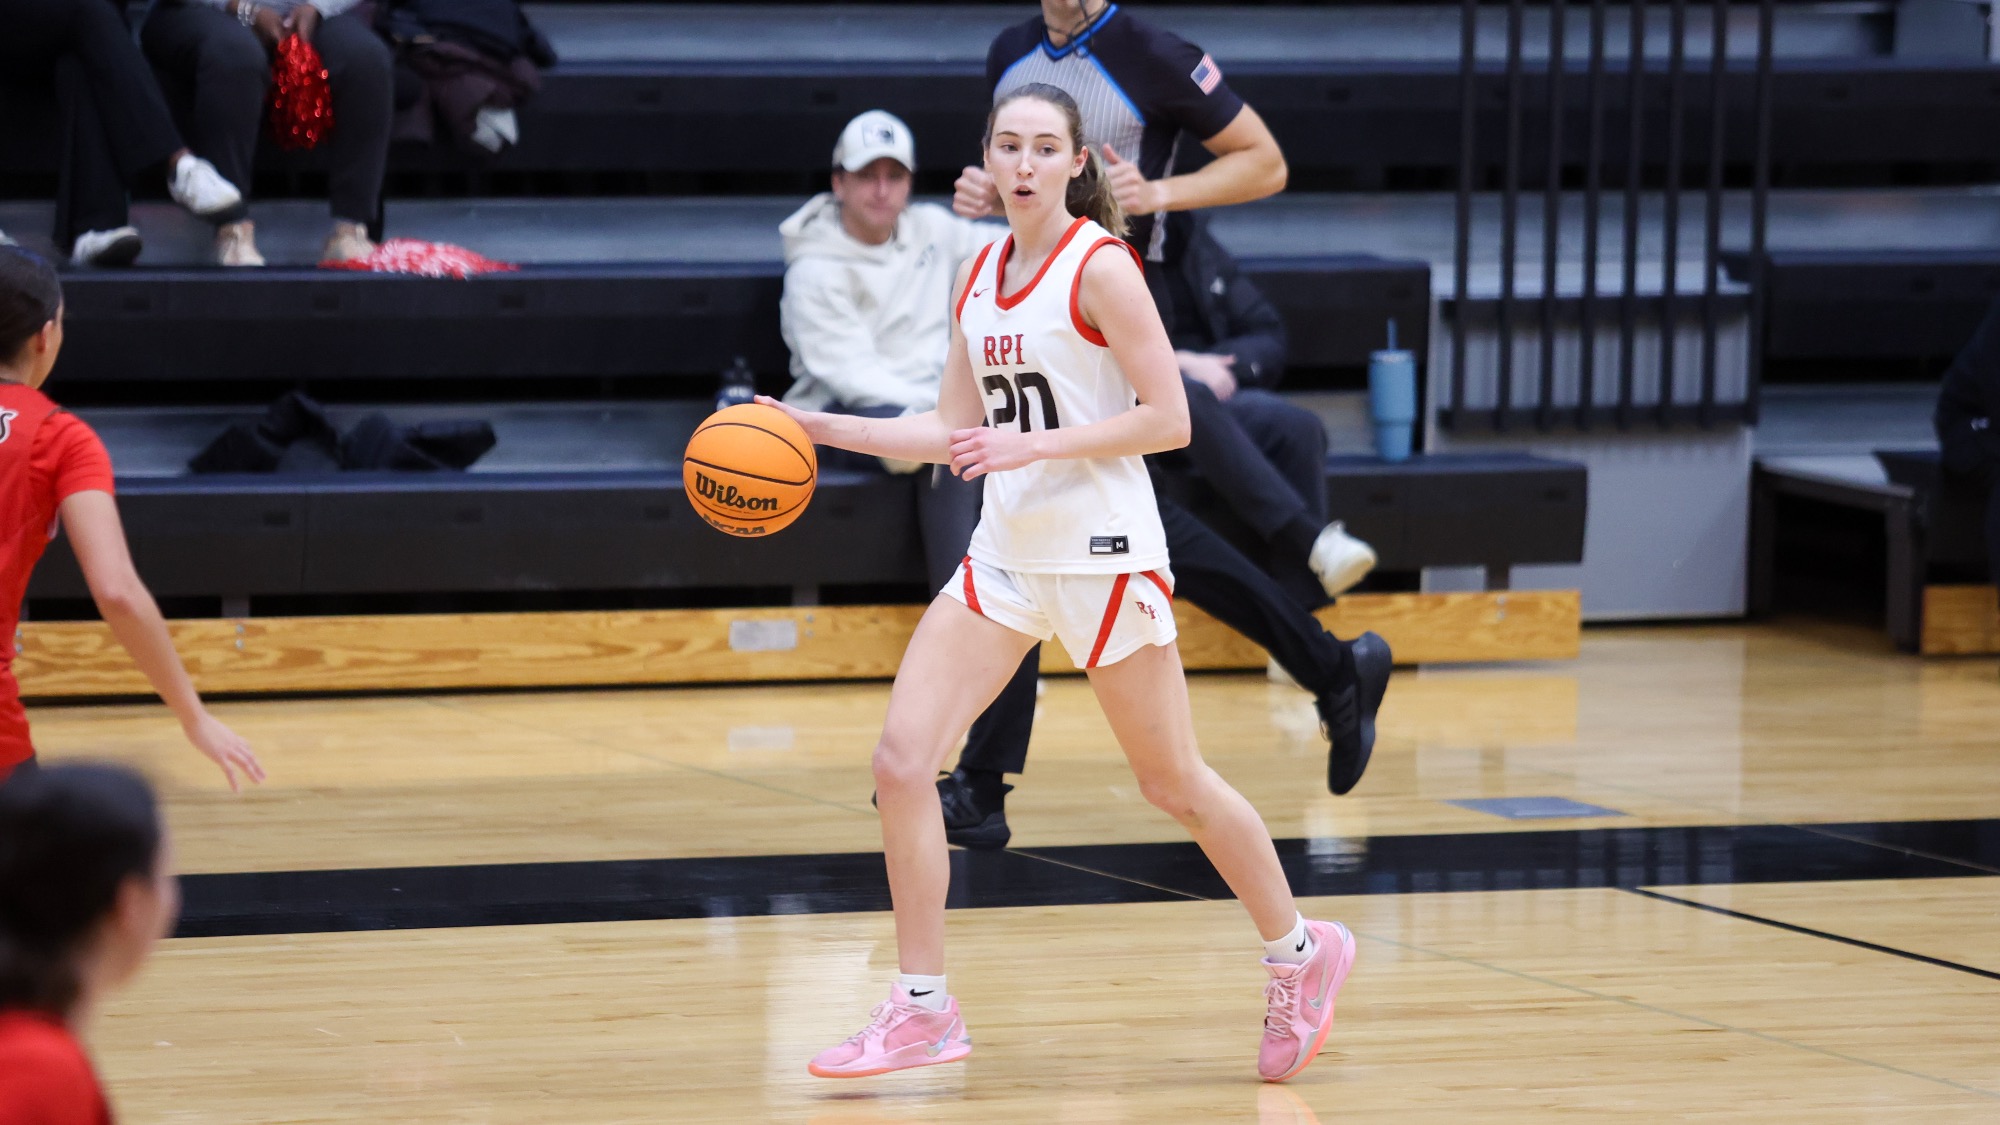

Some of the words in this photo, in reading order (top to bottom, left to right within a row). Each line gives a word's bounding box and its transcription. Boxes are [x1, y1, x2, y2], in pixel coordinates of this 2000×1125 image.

[984, 334, 1025, 366] RPI
[695, 471, 778, 511] Wilson
[1115, 541, 1124, 549] M
